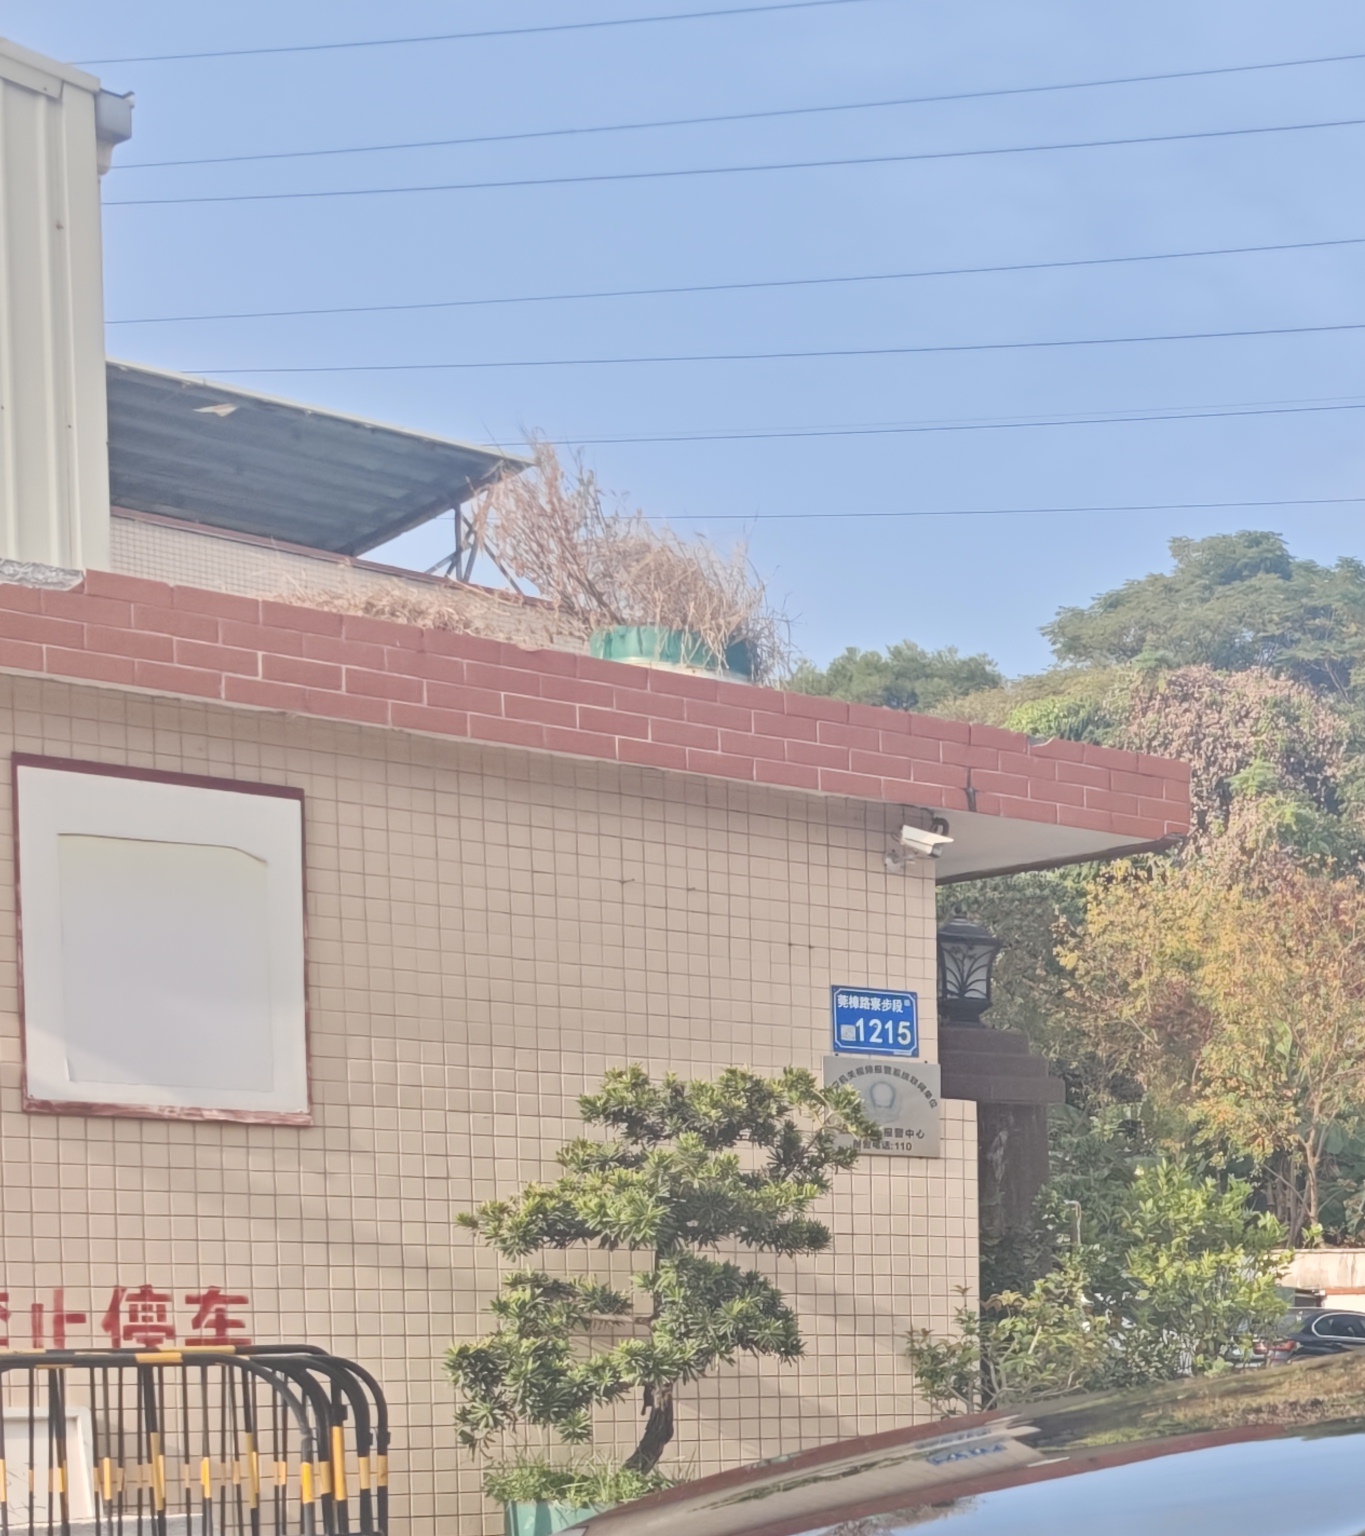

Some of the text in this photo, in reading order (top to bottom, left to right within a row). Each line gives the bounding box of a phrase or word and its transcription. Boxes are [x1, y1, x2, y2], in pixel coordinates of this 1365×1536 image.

[855, 1017, 912, 1046] 1215
[0, 1283, 252, 1350] 止停车
